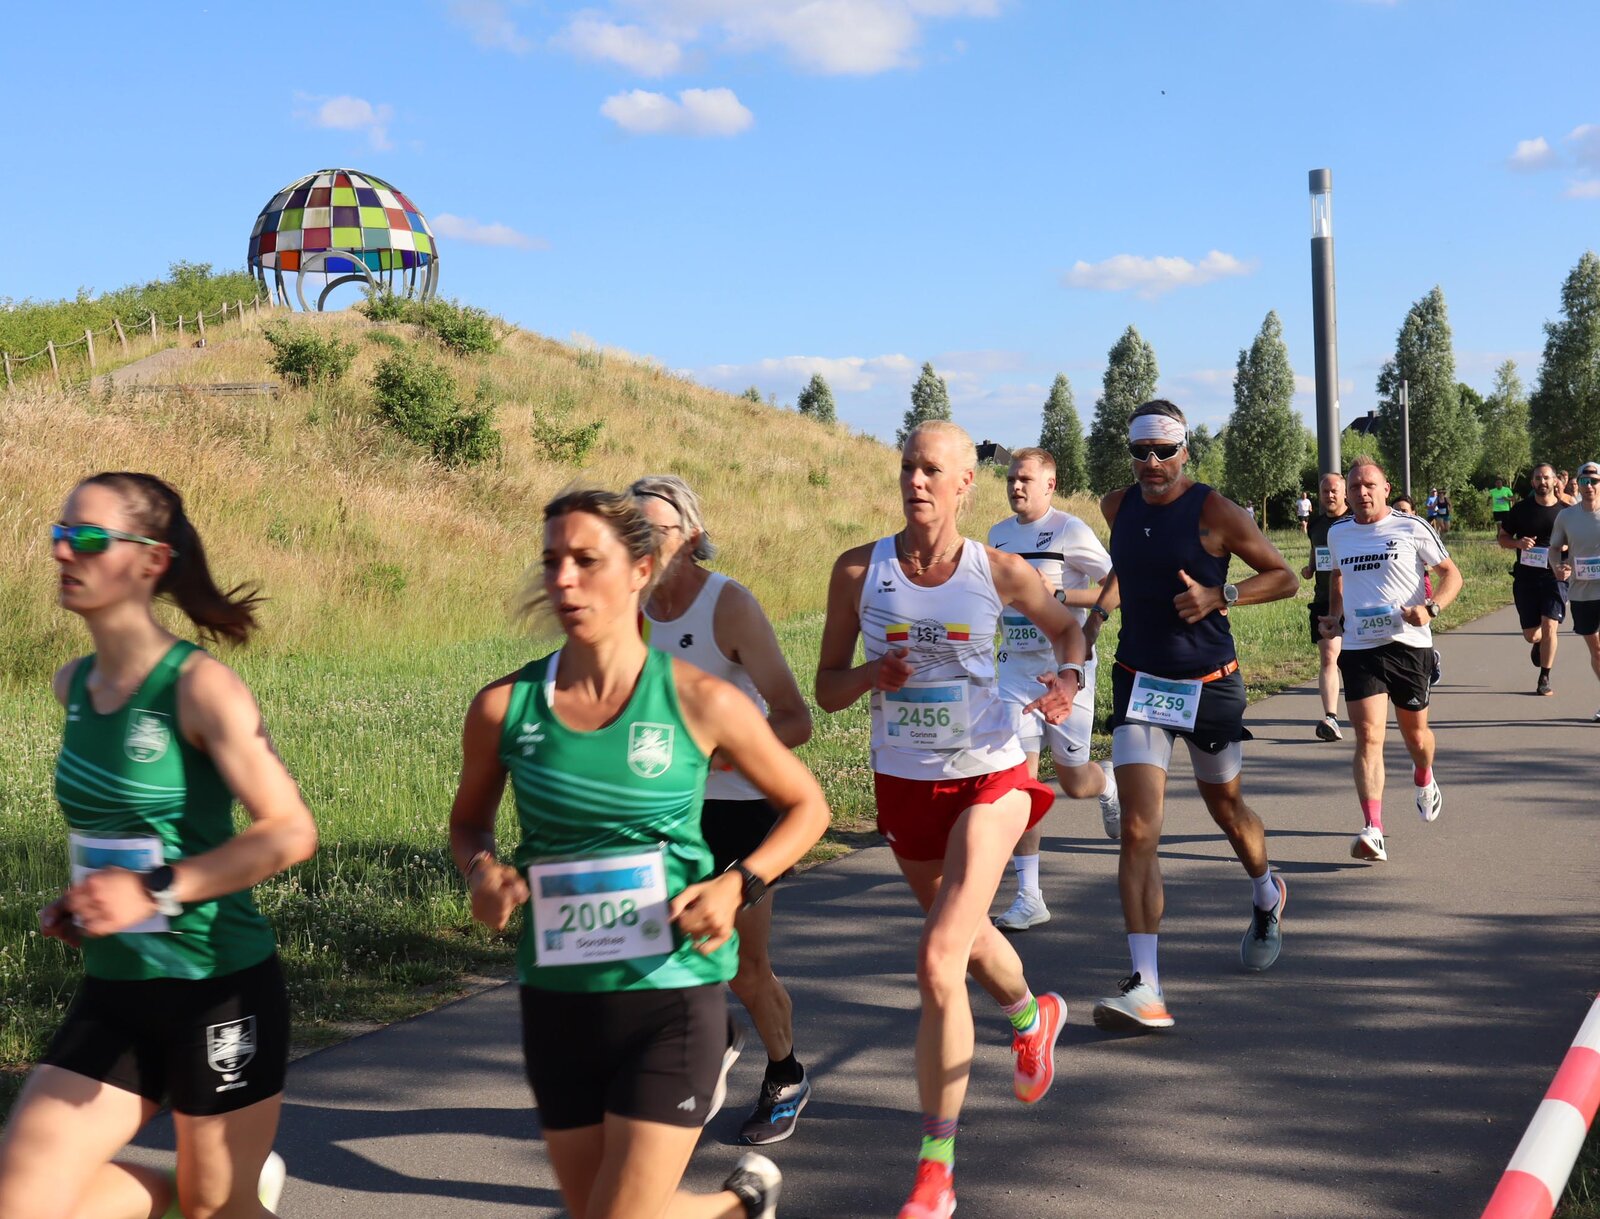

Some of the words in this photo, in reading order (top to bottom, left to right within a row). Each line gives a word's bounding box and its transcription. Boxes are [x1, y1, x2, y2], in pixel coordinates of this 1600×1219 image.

[1340, 553, 1399, 566] YESTERDAY'S
[1353, 562, 1381, 572] HERO
[1361, 615, 1393, 630] 2495
[1008, 627, 1038, 640] 2286
[1144, 692, 1185, 711] 2259
[897, 706, 950, 728] 2456
[1152, 710, 1172, 718] Markus
[910, 730, 938, 739] Corinna
[559, 897, 640, 933] 2008
